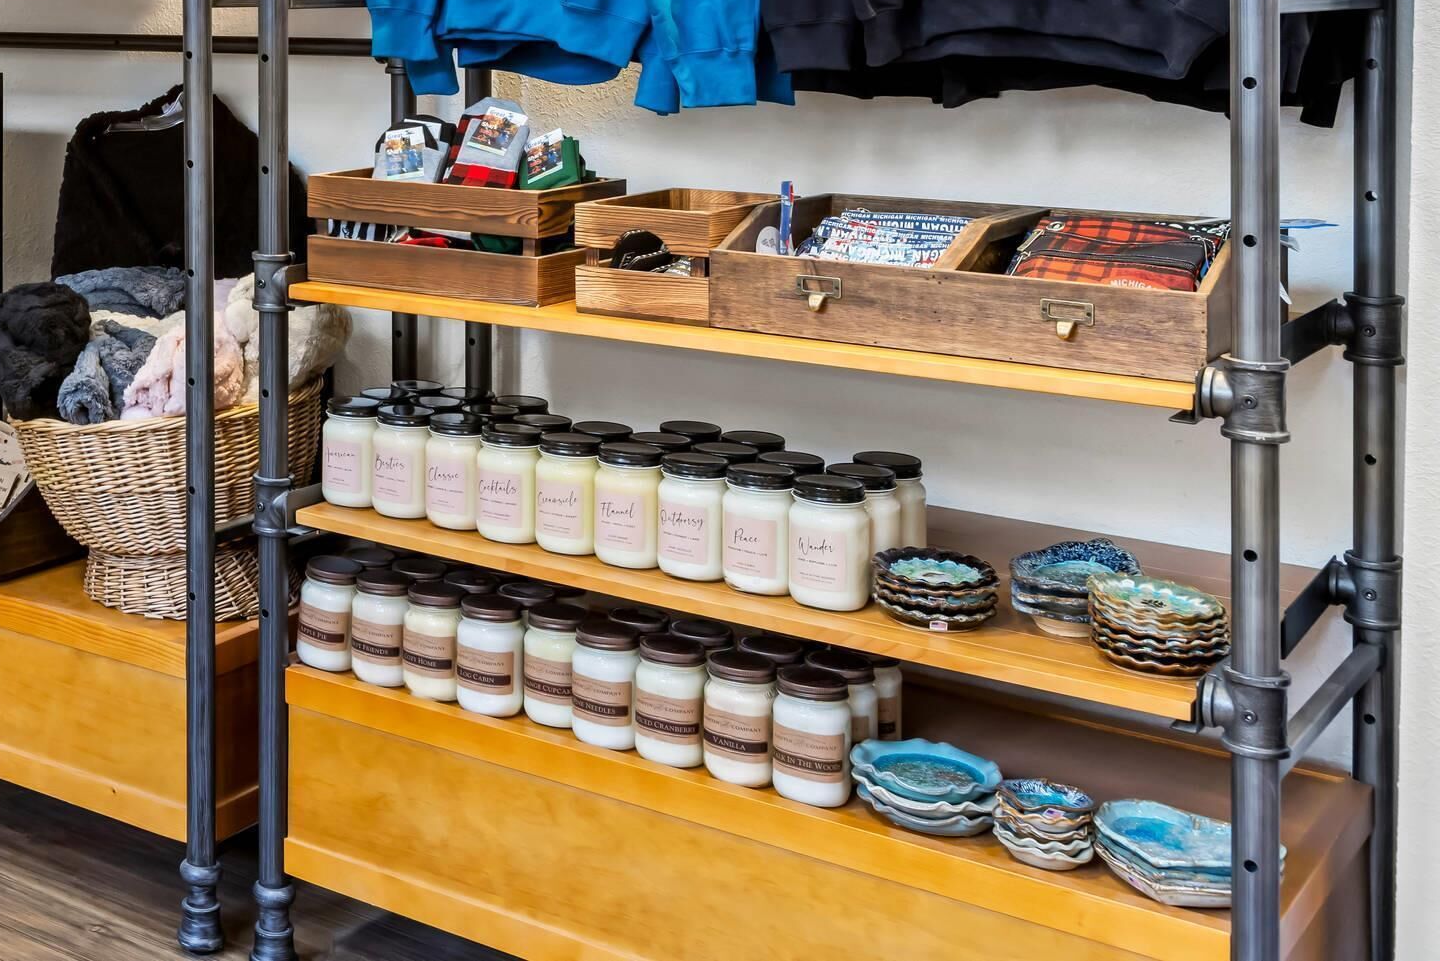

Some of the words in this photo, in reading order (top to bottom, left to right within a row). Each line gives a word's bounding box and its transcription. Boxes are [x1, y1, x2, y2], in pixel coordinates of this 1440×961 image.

[872, 213, 904, 221] MICHIGAN
[905, 214, 938, 222] MICHIGAN
[939, 216, 969, 225] MICHIGA
[1110, 278, 1153, 290] MICHIG
[428, 465, 459, 482] Classic
[479, 479, 517, 495] Cocktails
[600, 501, 635, 518] Flannel
[733, 527, 759, 544] Peace
[317, 632, 328, 640] PIE
[362, 644, 389, 655] FRIENDS
[418, 658, 437, 668] HOME
[472, 672, 495, 684] CABIN
[585, 702, 616, 715] NEEDLES
[653, 719, 696, 733] CRANBERRY
[712, 735, 746, 751] VANILLA
[798, 758, 812, 769] THE
